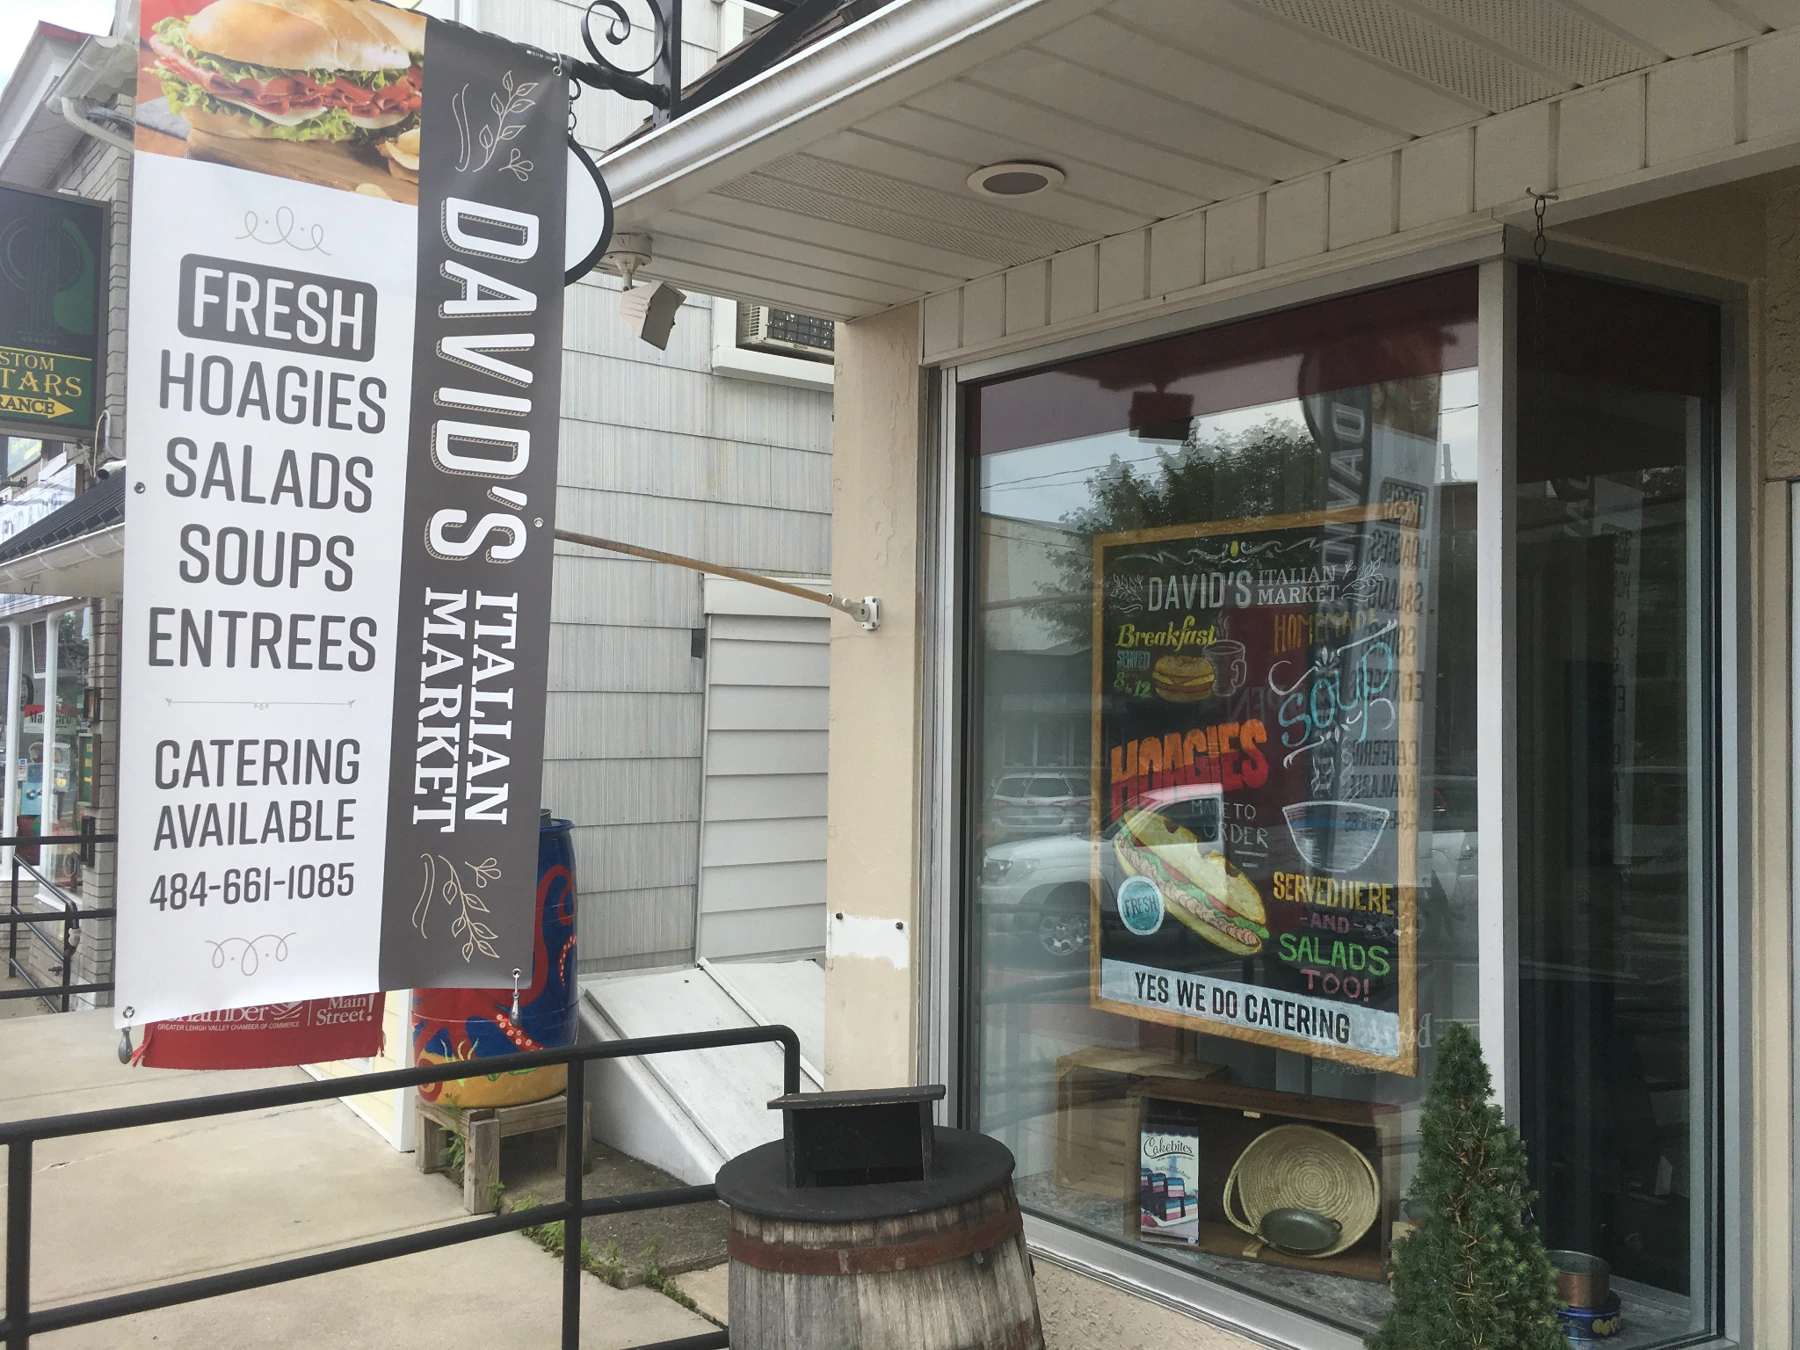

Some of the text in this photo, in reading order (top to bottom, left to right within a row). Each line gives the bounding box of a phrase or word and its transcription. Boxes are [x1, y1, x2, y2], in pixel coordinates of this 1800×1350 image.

[192, 266, 365, 351] FRESH
[159, 349, 387, 434] HOAGIES
[424, 197, 540, 564] DAVID'S
[165, 436, 374, 514] SALADS
[178, 523, 355, 592] SOUPS
[1148, 564, 1339, 612] DAVID'S ITALIAN
[1256, 584, 1340, 606] MARKET
[148, 606, 378, 673] ENTREES
[1115, 615, 1218, 652] Breakfast
[412, 587, 468, 833] MARKET
[464, 590, 519, 825] ITALIAN
[1133, 680, 1152, 699] 12
[154, 738, 361, 790] CATERING
[1111, 718, 1269, 822] HOAGIES
[153, 798, 357, 852] AVAILABLE
[1234, 803, 1257, 820] TO
[149, 862, 355, 912] 484-661-1085
[1124, 894, 1158, 917] FRESH
[1273, 870, 1395, 915] SERVED HERE
[1277, 932, 1391, 976] SALADS
[326, 994, 367, 1010] Main
[1135, 971, 1169, 1002] YES
[1176, 978, 1206, 1011] WE
[1212, 987, 1238, 1018] DO
[1245, 994, 1351, 1044] CATERING
[1299, 966, 1372, 1003] TOO!
[157, 1023, 184, 1031] GREATER
[185, 1024, 207, 1032] LEHIGH
[208, 1024, 230, 1032] VALLEY
[230, 1023, 259, 1031] CHAMBER
[268, 1020, 300, 1029] COMMERCE
